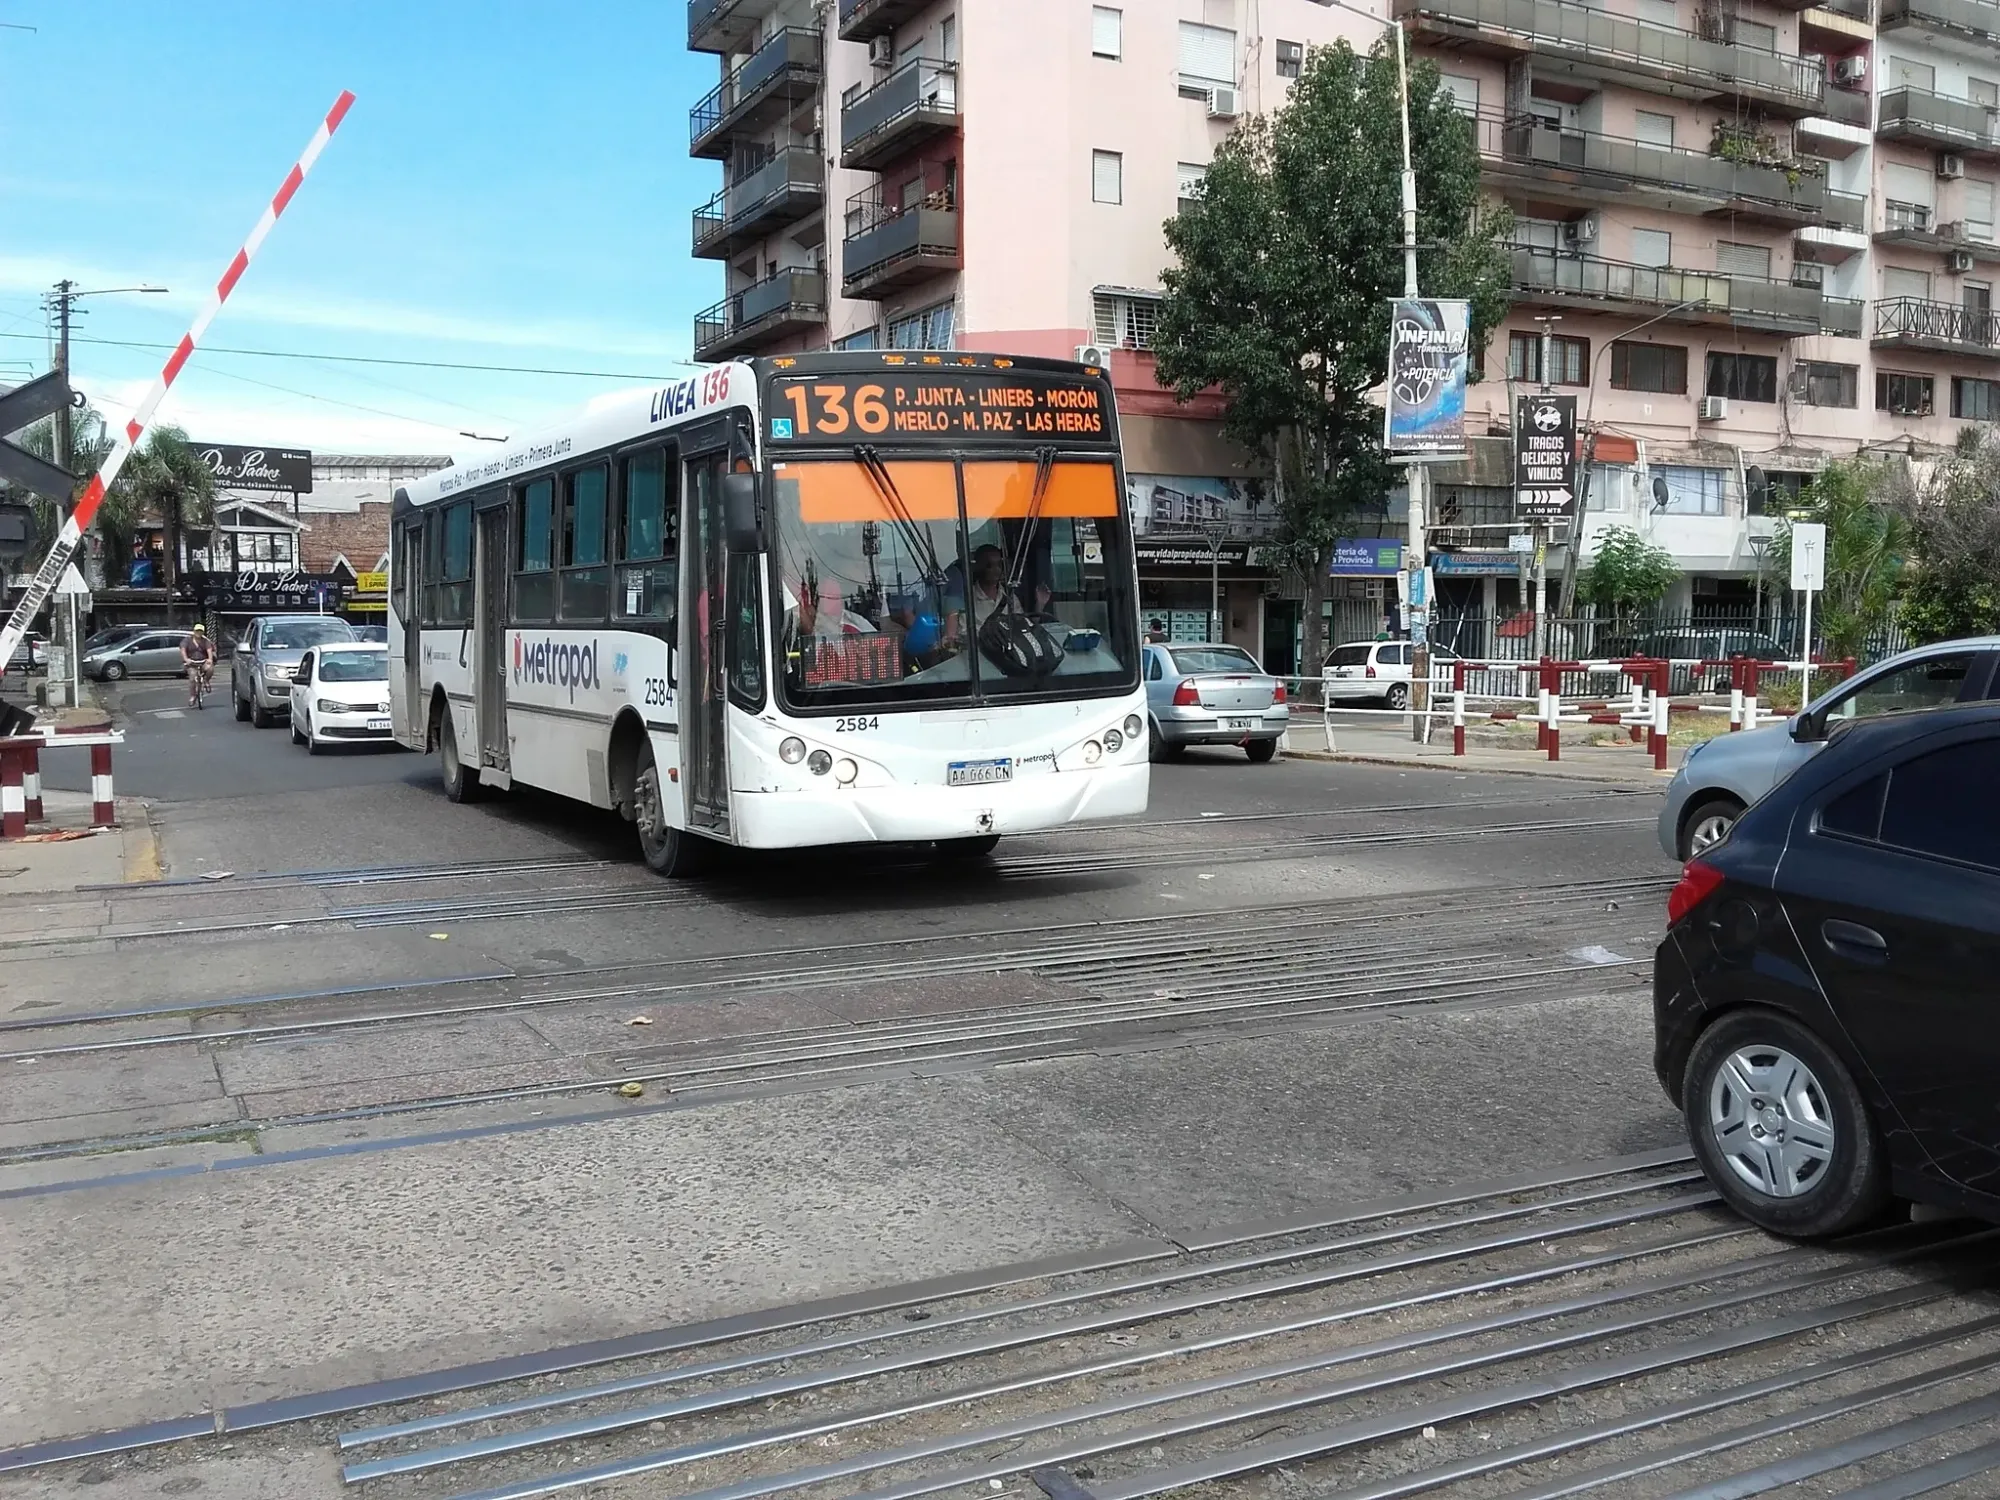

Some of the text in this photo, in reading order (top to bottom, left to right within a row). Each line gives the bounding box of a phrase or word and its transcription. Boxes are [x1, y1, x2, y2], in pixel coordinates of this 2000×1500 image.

[1400, 330, 1464, 343] INFINIA
[1417, 345, 1463, 353] TURBOCLEAN
[650, 366, 731, 423] LINEA 136
[895, 388, 910, 405] P.
[914, 388, 966, 406] JUNTA
[979, 388, 1034, 407] LINIERS
[1047, 386, 1098, 408] MORÓN
[785, 384, 890, 434] 136
[894, 411, 948, 431] MERLO
[963, 411, 980, 431] M.
[983, 412, 1013, 431] PAZ
[1026, 412, 1053, 431] LAS
[1056, 413, 1101, 432] HERAS
[529, 443, 552, 463] Primera
[553, 437, 571, 456] Junta
[1528, 436, 1564, 450] TRAGOS
[233, 450, 281, 481] Padres
[1521, 452, 1570, 465] DELICIAS Y
[1527, 467, 1563, 480] VINILOS
[1137, 549, 1243, 560] www.vidalpropiedade.com.ar
[1338, 556, 1374, 564] Provincia
[1357, 546, 1368, 556] de
[234, 568, 309, 594] Dos Padres
[8, 583, 46, 631] MARTIN
[524, 637, 600, 704] Metropol
[645, 678, 673, 707] 2584
[836, 716, 879, 732] 2584
[952, 770, 966, 783] AA
[995, 766, 1010, 779] CN
